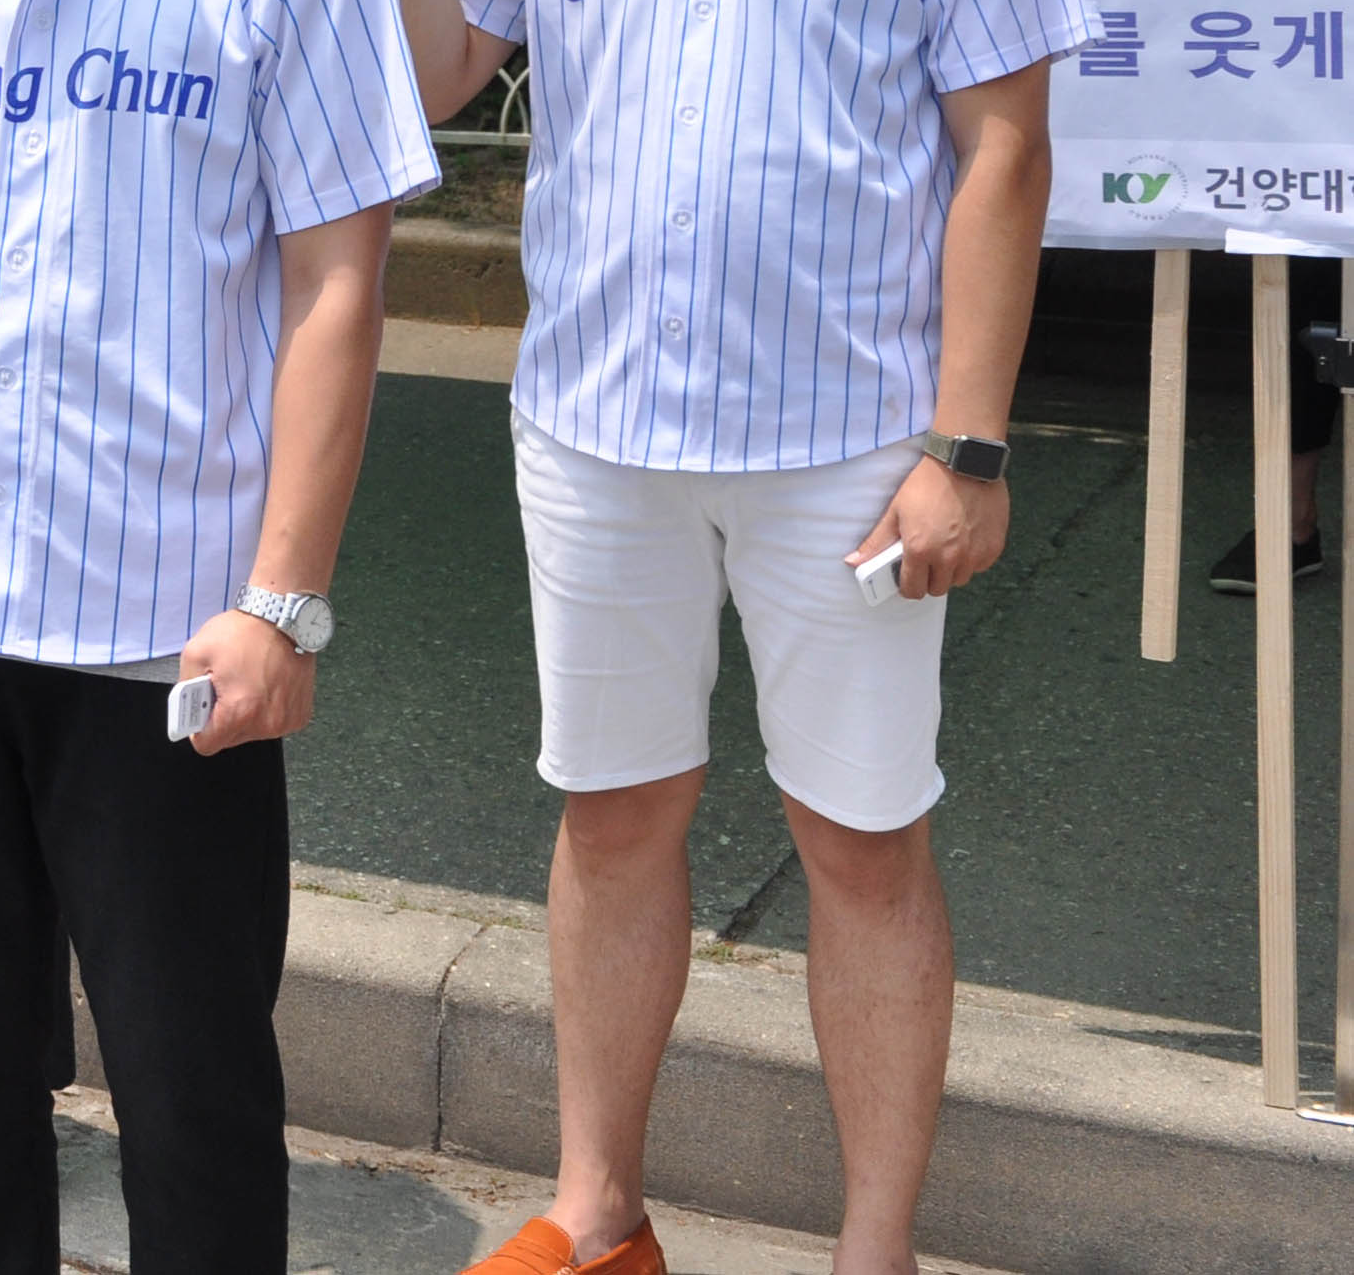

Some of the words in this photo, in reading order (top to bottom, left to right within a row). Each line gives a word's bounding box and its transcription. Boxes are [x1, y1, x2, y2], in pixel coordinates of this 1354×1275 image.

[1183, 11, 1344, 80] 웃게
[66, 47, 214, 120] Chun
[1205, 166, 1354, 213] 건양대
